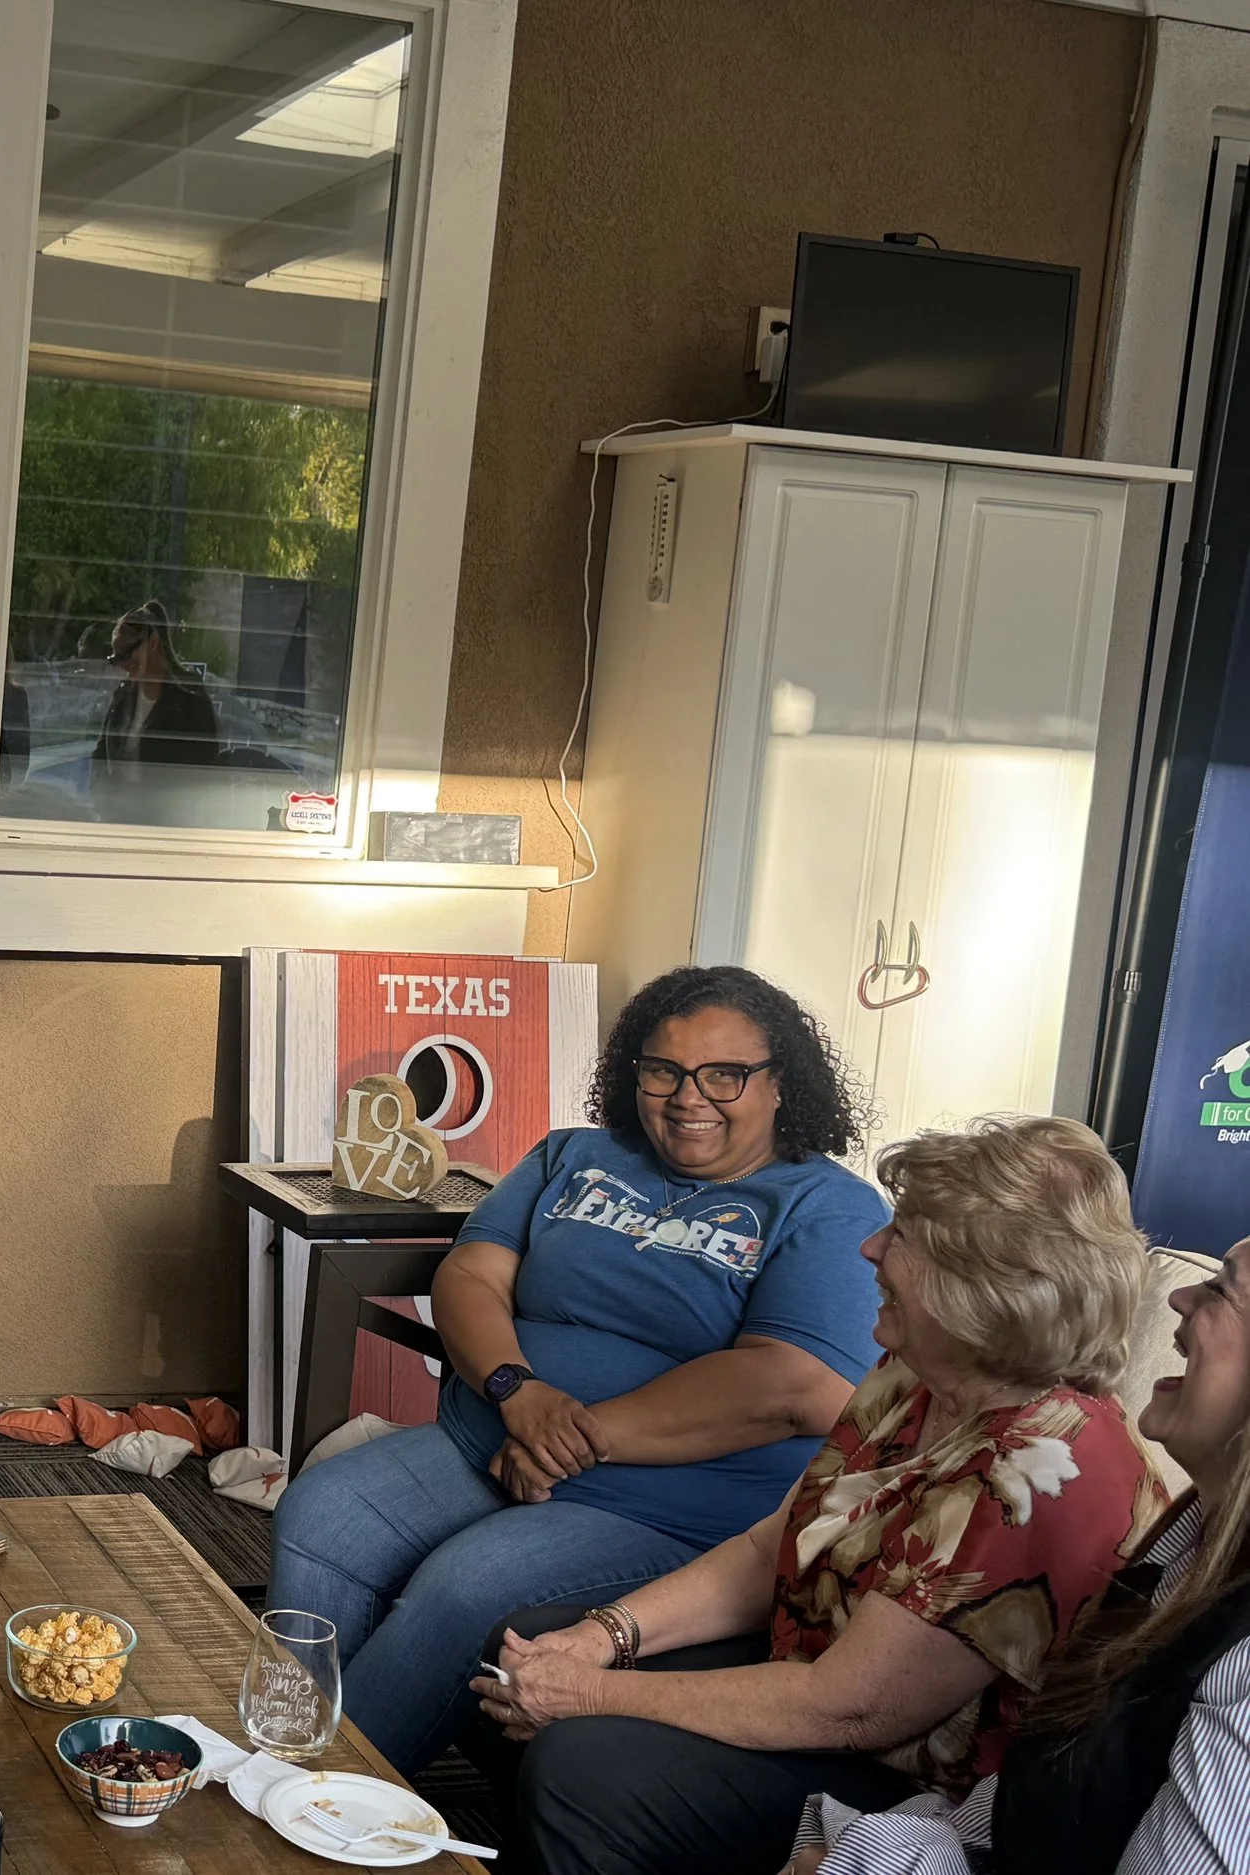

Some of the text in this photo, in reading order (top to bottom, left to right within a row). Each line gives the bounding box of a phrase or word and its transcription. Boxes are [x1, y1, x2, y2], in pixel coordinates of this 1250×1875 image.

[379, 974, 510, 1017] TEXAS
[1223, 1106, 1243, 1121] for
[572, 1192, 754, 1264] EXPLORE
[262, 1670, 301, 1701] Ring
[294, 1696, 319, 1719] look
